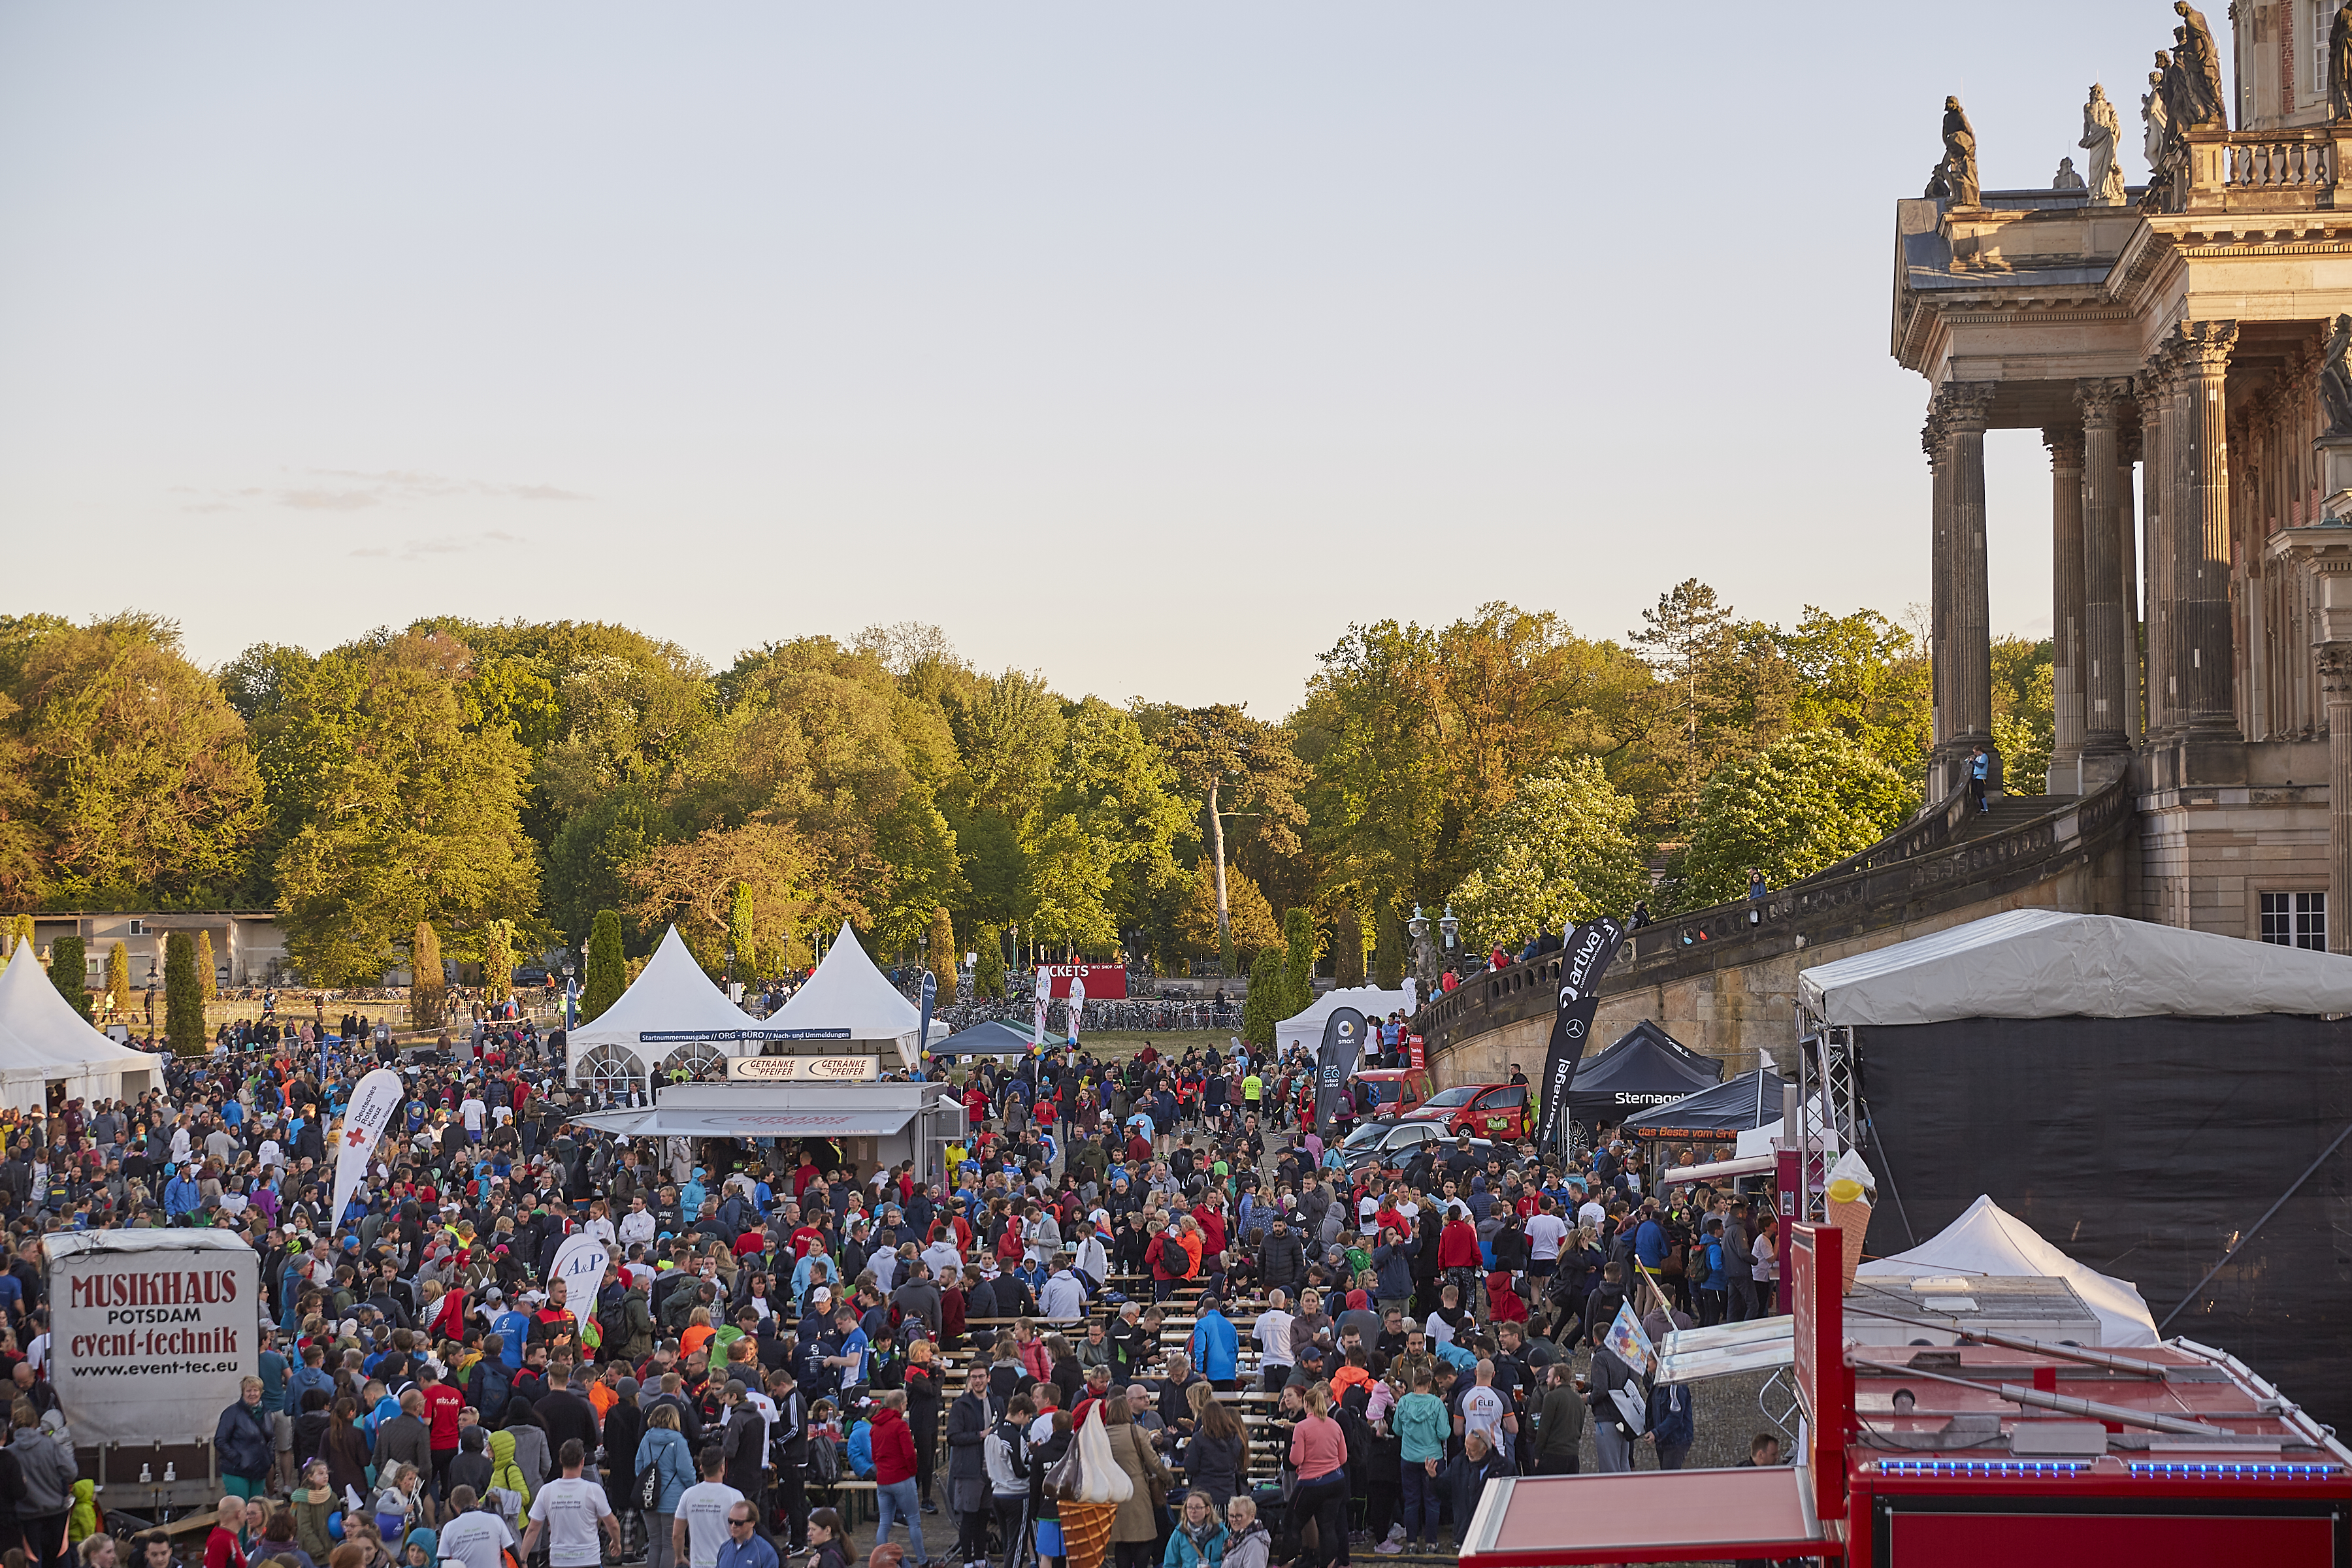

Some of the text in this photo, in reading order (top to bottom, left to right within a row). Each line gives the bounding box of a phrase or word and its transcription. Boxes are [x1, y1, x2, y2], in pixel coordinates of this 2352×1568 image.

[1037, 965, 1089, 977] CKETS
[1578, 938, 1605, 989] customized sportswear
[742, 1030, 764, 1039] BÜRO
[805, 1032, 849, 1040] Ummeldungen
[751, 1058, 795, 1068] GETRÄNKE
[821, 1058, 867, 1068] GETRÄNKE
[1323, 1069, 1340, 1079] EQ
[354, 1085, 377, 1122] Deutsches
[383, 1097, 397, 1119] Menschen
[1543, 1058, 1571, 1142] Sternagel
[361, 1103, 376, 1124] Rotes
[367, 1107, 382, 1128] Kreuz
[1638, 1126, 1657, 1137] das
[1659, 1127, 1690, 1137] Beste
[1716, 1129, 1738, 1139] Grill
[566, 1253, 604, 1277] A&P
[71, 1269, 237, 1308] MUSIKHAUS
[108, 1307, 201, 1324] POTSDAM
[72, 1326, 238, 1357] event-technik
[72, 1361, 238, 1377] www.event-tec.eu
[436, 1397, 459, 1405] mbs.de
[642, 1468, 655, 1509] adidas
